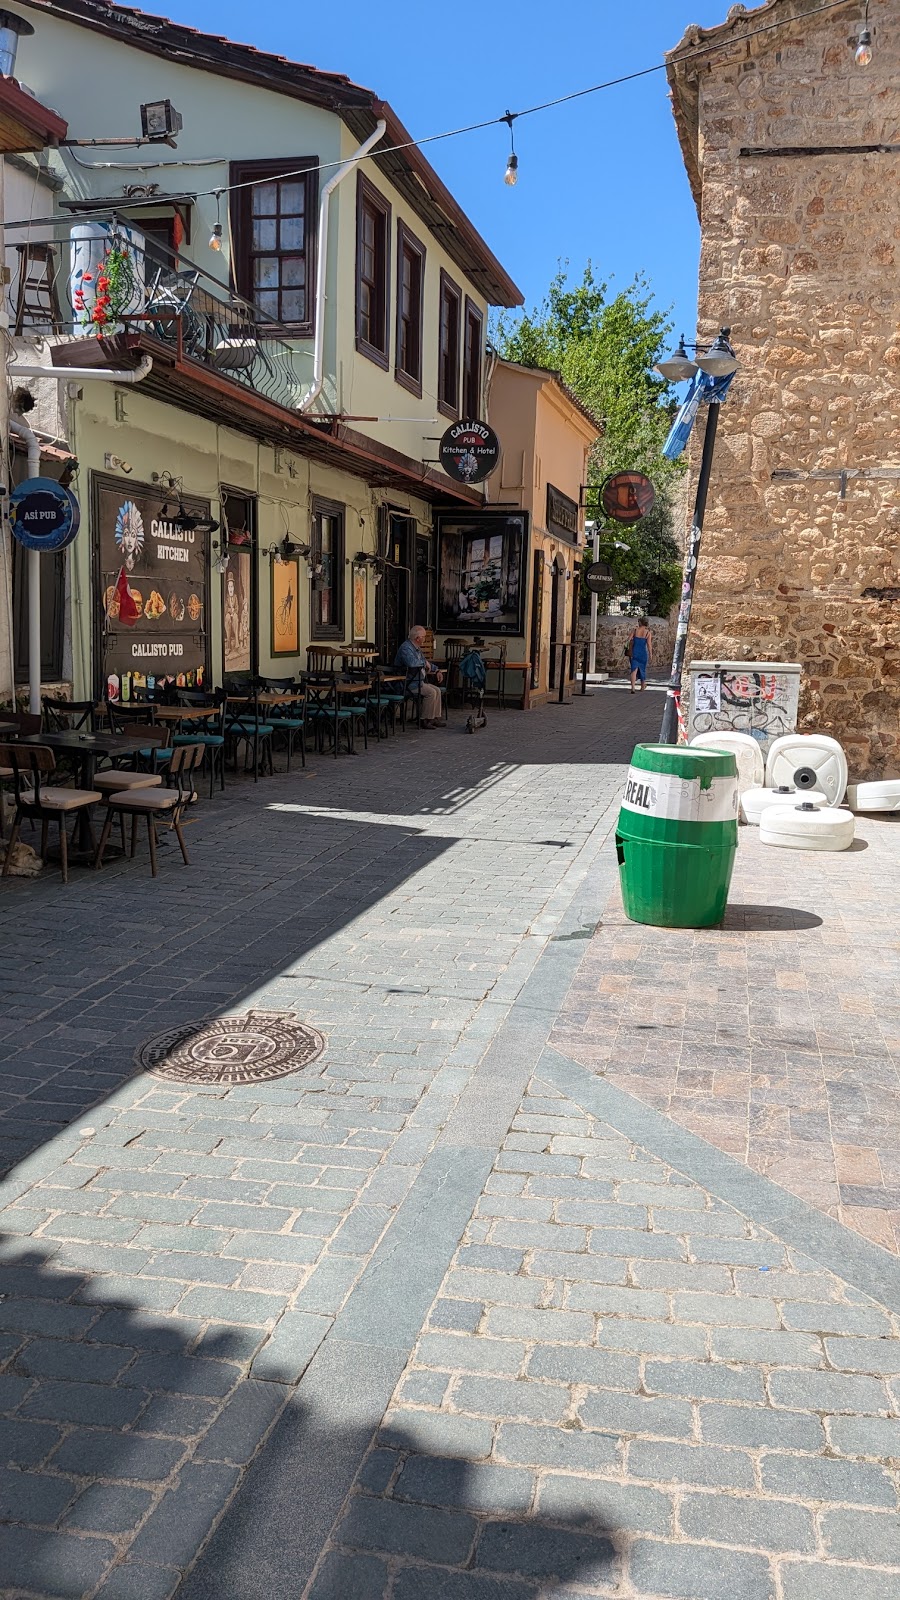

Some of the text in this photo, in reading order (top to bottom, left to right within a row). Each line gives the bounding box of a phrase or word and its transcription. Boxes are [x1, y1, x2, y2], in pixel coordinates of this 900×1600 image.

[24, 510, 57, 520] ASİ PUB
[157, 544, 189, 562] KITCHEN
[132, 643, 183, 656] CALLISTO PUB
[625, 779, 650, 809] REAL
